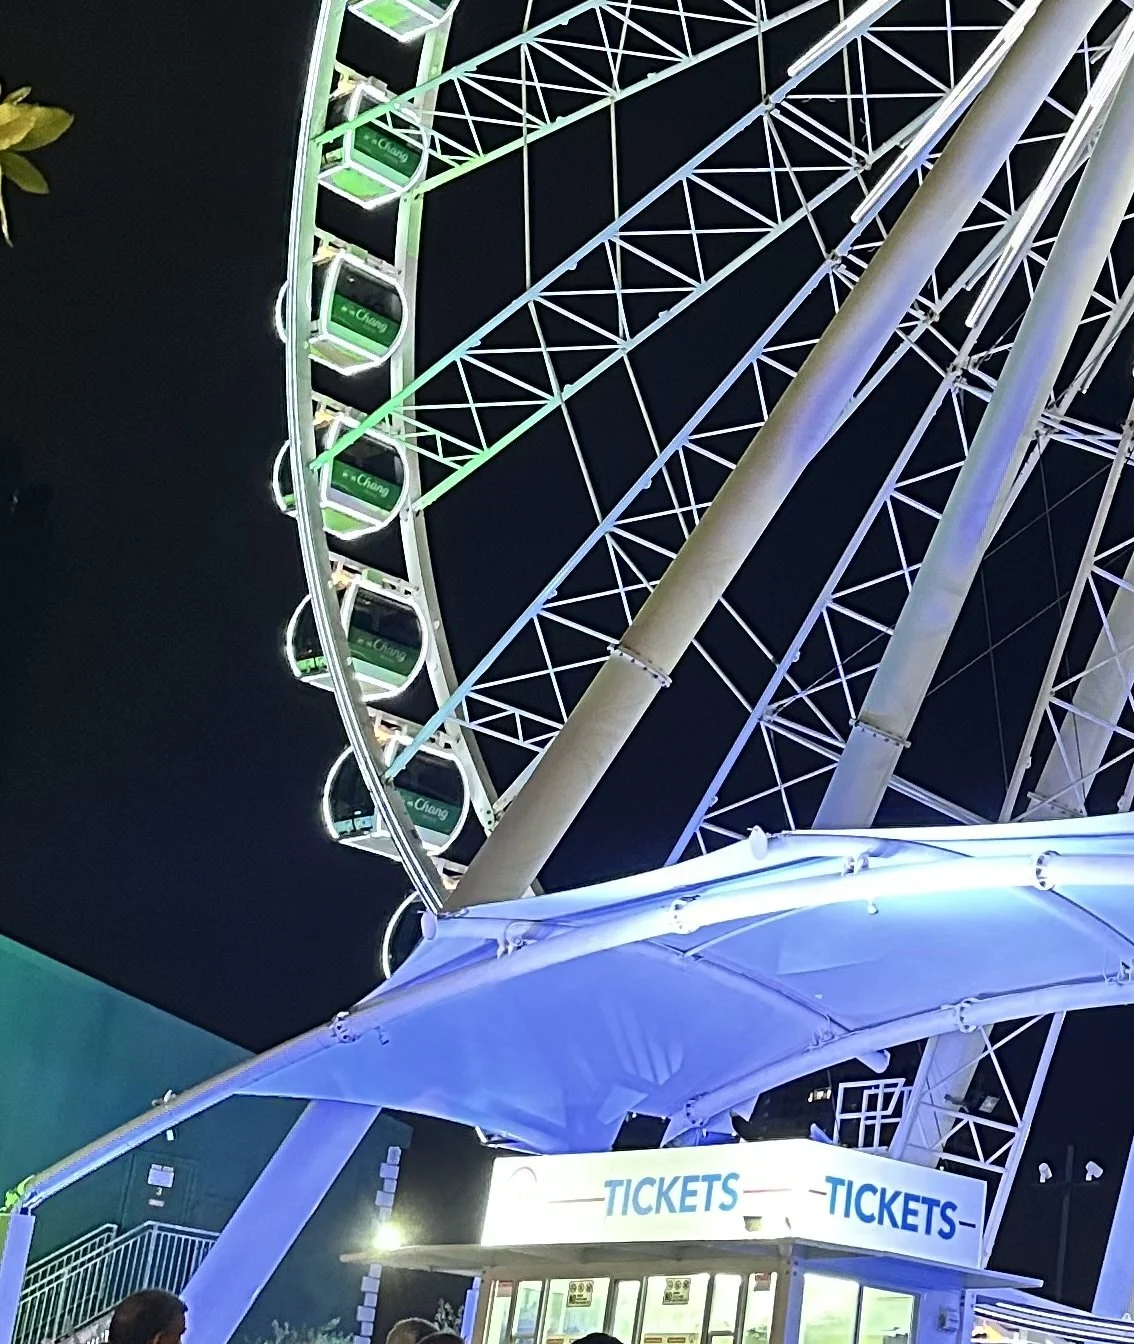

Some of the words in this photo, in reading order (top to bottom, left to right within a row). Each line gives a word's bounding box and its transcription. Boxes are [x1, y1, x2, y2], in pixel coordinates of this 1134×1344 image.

[377, 138, 408, 163] Chang
[355, 308, 388, 333] Chang
[357, 474, 390, 498] Chang
[373, 639, 407, 663] Chang
[414, 798, 449, 821] Chang
[604, 1172, 741, 1216] TICKETS
[825, 1175, 958, 1240] TICKETS
